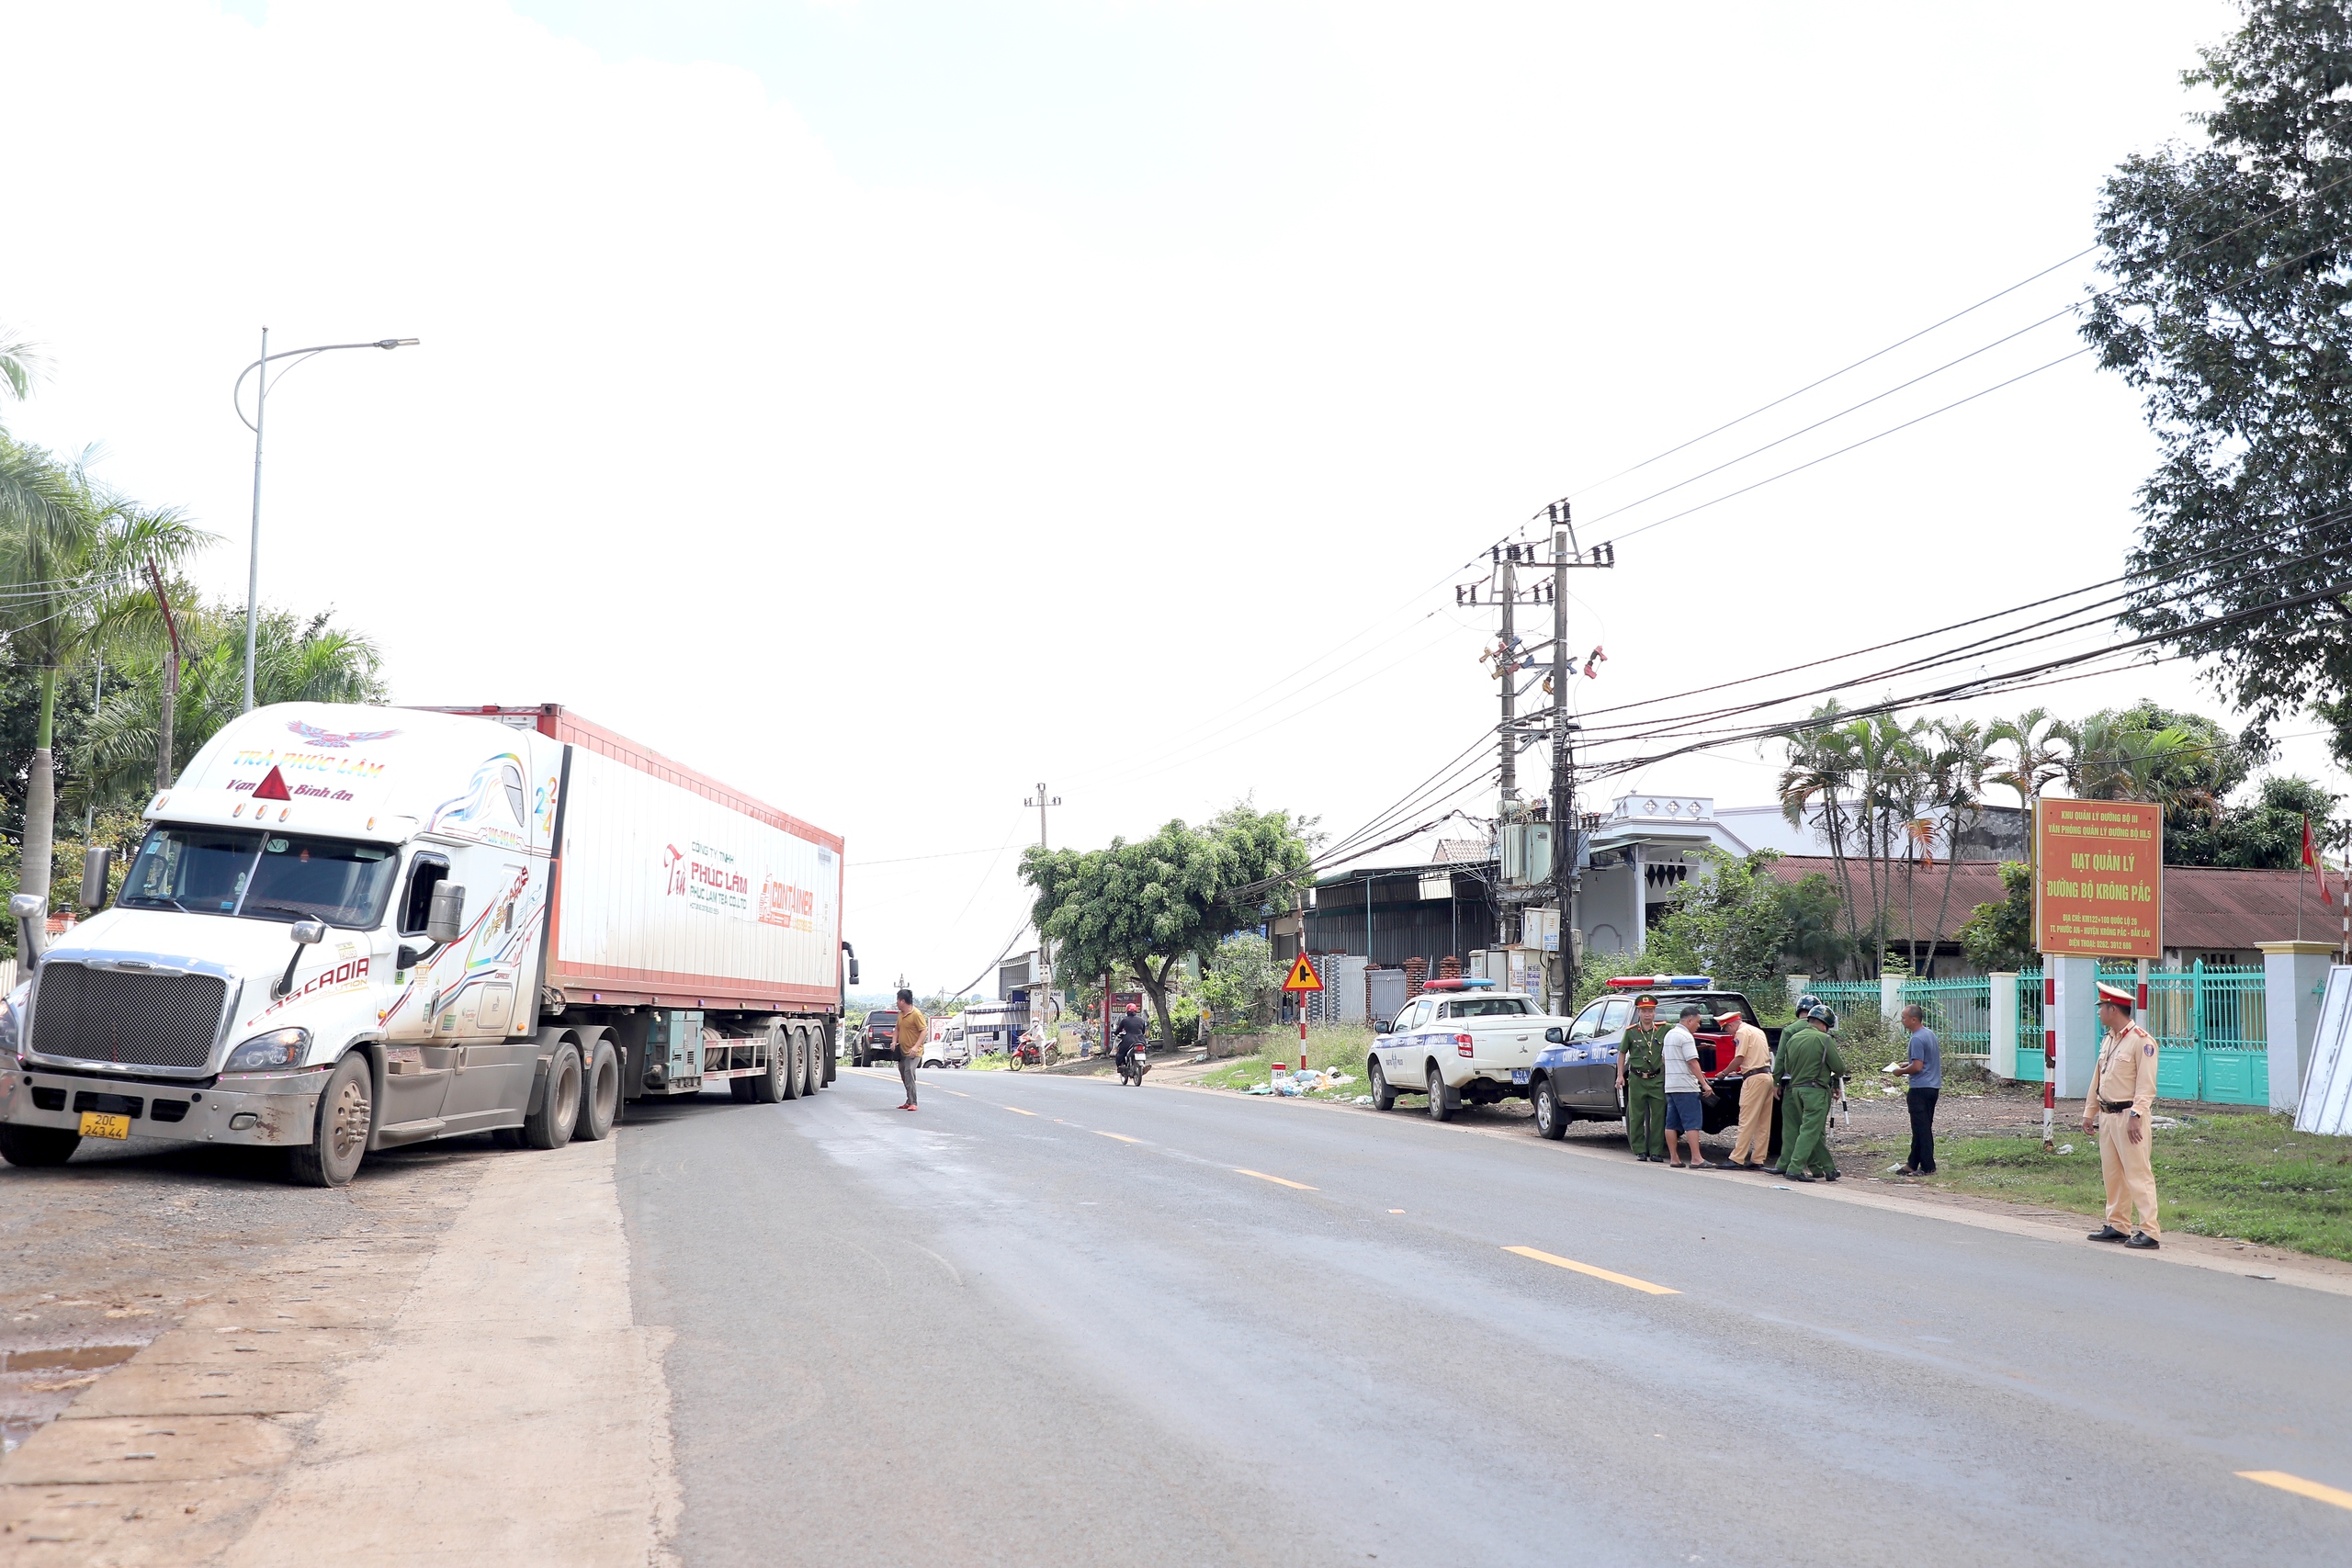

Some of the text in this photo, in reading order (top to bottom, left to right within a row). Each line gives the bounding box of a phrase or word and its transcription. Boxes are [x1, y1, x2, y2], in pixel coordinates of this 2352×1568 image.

[233, 749, 385, 779] TRÀ PHÚC LÂM
[226, 779, 257, 792] Vạn
[330, 789, 355, 802] An
[2061, 810, 2074, 820] KHU
[2075, 809, 2091, 821] QUẢN
[2092, 811, 2099, 821] LÝ
[2100, 811, 2121, 823] ĐƯỜNG
[2122, 813, 2131, 825] BỘ
[2082, 824, 2099, 836] QUẢN
[2100, 827, 2108, 837] LÝ
[2109, 827, 2129, 838] ĐƯỜNG
[2130, 828, 2139, 840] BỘ
[2140, 829, 2151, 839] III.5
[709, 848, 718, 859] TY
[718, 851, 734, 864] TNHH
[2071, 849, 2135, 874] HẠT QUẢN LÝ
[691, 862, 748, 895] PHÚC LÂM
[2046, 877, 2151, 902] ĐƯỜNG BỘ KRÔNG PẮC
[718, 893, 729, 906] TEA
[772, 879, 814, 918] CONTAINER
[2063, 913, 2072, 923] ĐỊA
[2110, 914, 2124, 925] QUỐC
[2124, 917, 2131, 926] LỘ
[2074, 926, 2081, 934] AN
[2068, 938, 2080, 948] ĐIỆN
[247, 958, 369, 1027] CASCADIA
[303, 978, 368, 1004] EVOLUTION
[1517, 1069, 1528, 1077] 47A
[95, 1114, 117, 1126] 20C
[85, 1124, 122, 1138] 243.44
